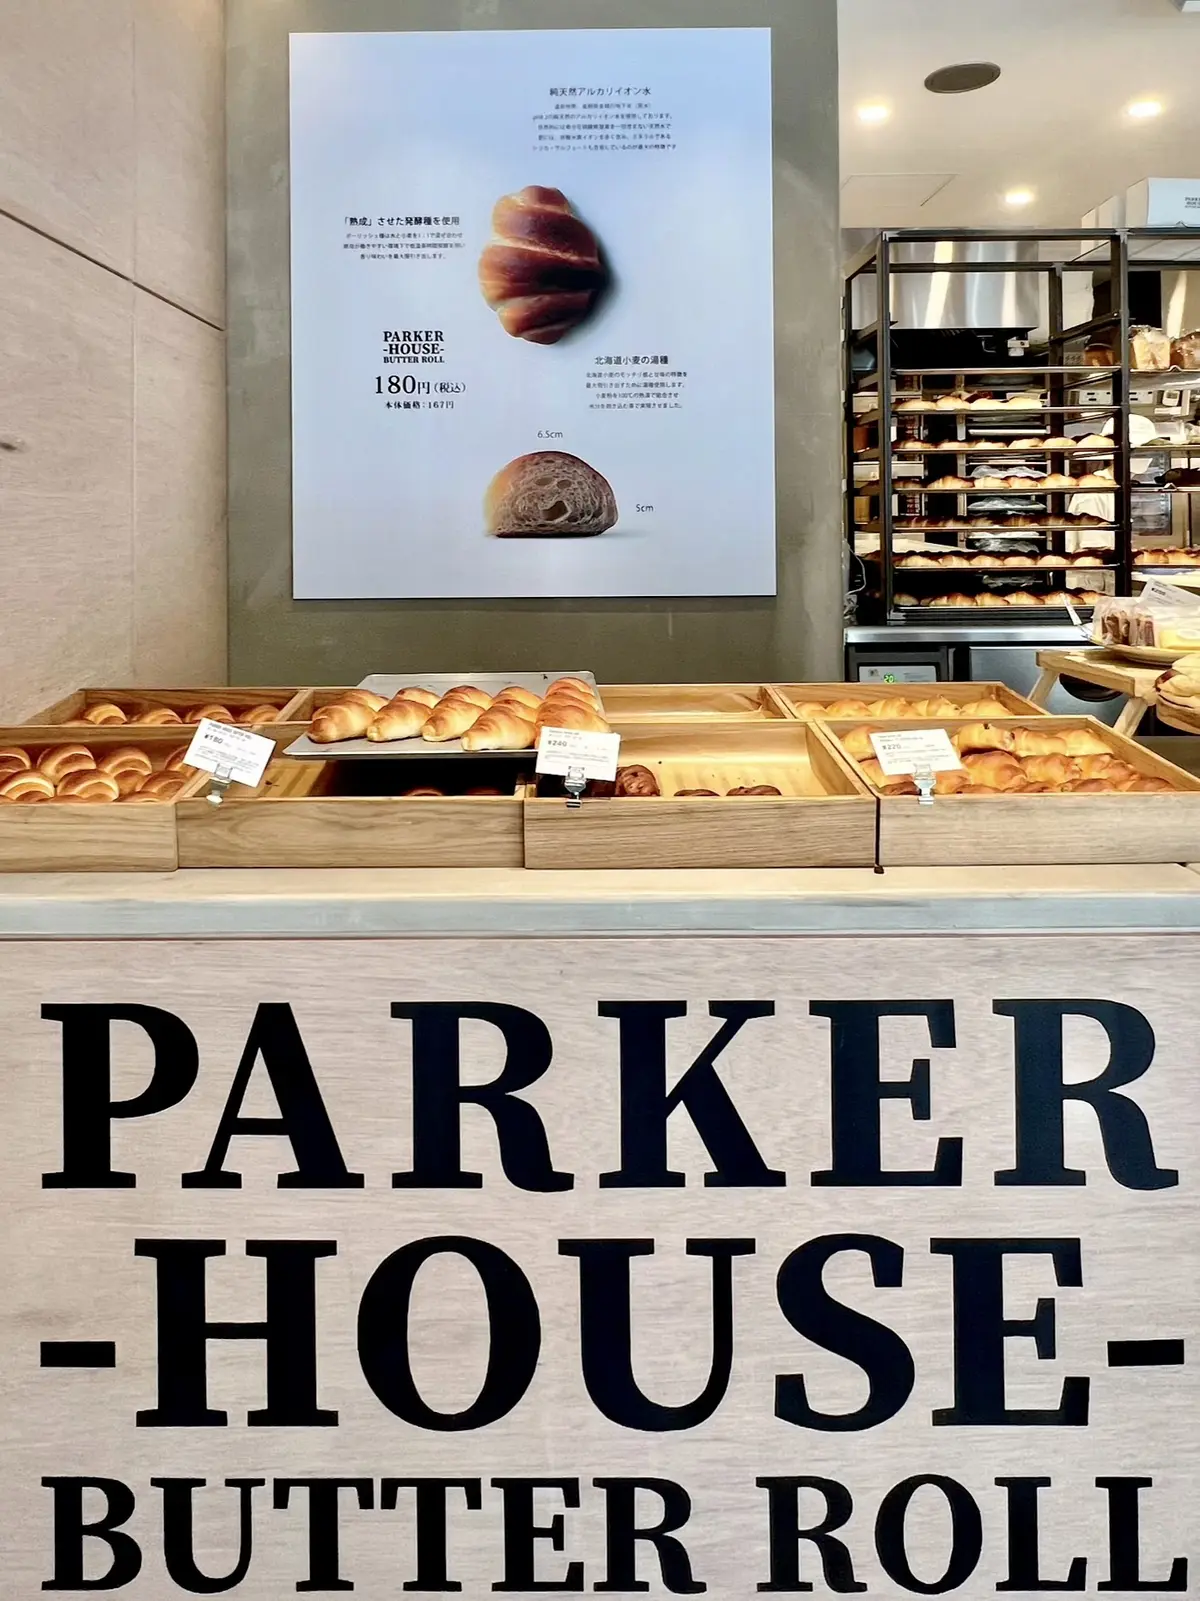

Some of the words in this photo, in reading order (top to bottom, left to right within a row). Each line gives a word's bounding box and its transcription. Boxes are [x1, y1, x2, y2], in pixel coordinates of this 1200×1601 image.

[549, 86, 652, 97] 純天然アルカリイオン水
[343, 216, 460, 227] 「熟成」させた発酵種を使用
[383, 330, 444, 342] PARKER
[383, 343, 445, 355] -HOUSE-
[383, 356, 419, 364] BUTTER
[421, 356, 445, 364] ROLL
[594, 355, 669, 365] 北海道小麦の湯種
[537, 430, 564, 438] 6.5cm
[636, 504, 654, 512] 5cm
[41, 999, 1178, 1192] PARKER
[40, 1234, 1185, 1432] -HOUSE-
[41, 1476, 707, 1595] BUTTER
[756, 1474, 1188, 1595] ROLL
